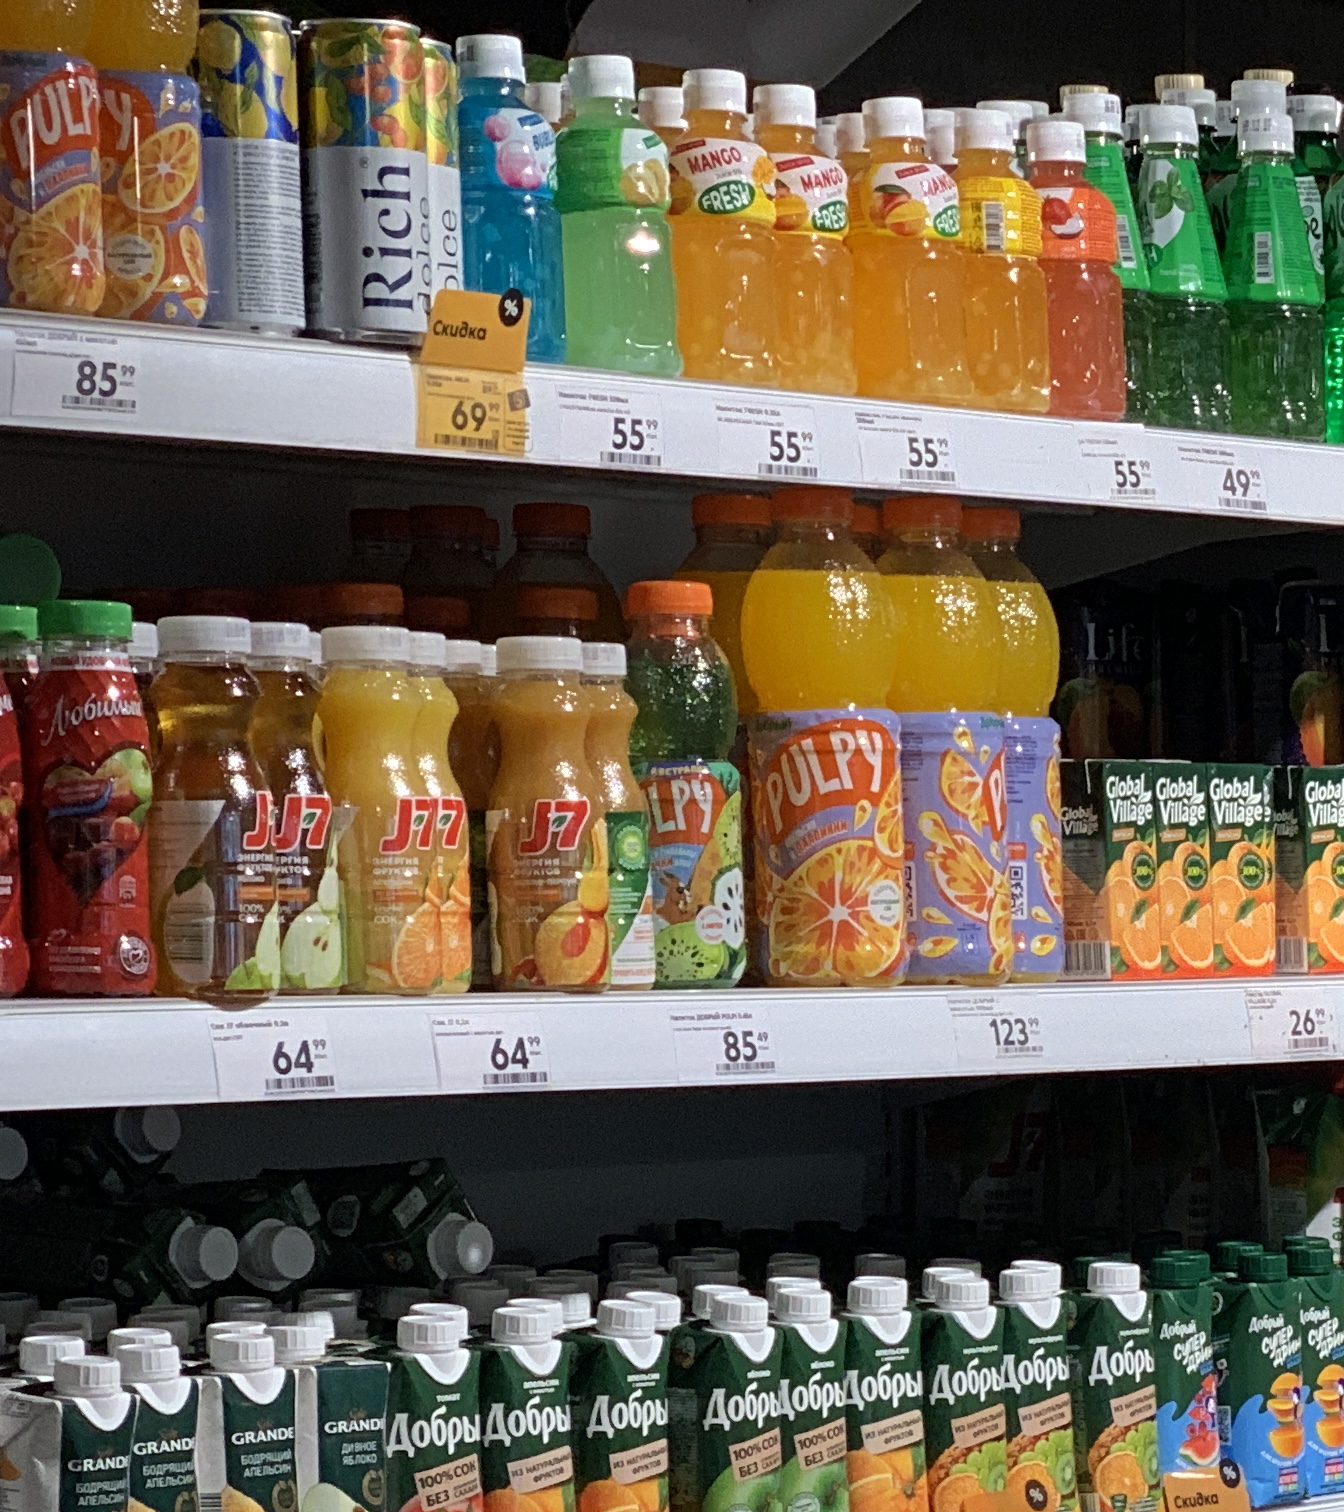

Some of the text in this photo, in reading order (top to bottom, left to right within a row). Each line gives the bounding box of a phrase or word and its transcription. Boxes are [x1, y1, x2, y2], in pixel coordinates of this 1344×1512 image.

[686, 147, 741, 175] MANGO
[799, 167, 844, 194] MANGO
[700, 182, 754, 213] FRESH
[362, 163, 413, 312] Rich
[432, 321, 487, 342] Скидка
[75, 360, 135, 397] 85 99
[451, 401, 487, 432] 69
[611, 418, 658, 450] 55 99
[768, 430, 813, 463] 55 99
[907, 437, 938, 468] 55
[1222, 468, 1251, 497] 49
[766, 729, 884, 833] PULPY
[1106, 774, 1147, 803] Global
[274, 793, 333, 850] J7
[380, 796, 438, 853] J7
[520, 798, 591, 852] J7
[1110, 800, 1153, 827] Village
[989, 1018, 1040, 1046] 123 99
[1288, 1009, 1316, 1036] 26
[272, 1038, 326, 1074] 64 99
[490, 1036, 541, 1070] 64 99
[723, 1031, 769, 1062] 85 49
[1248, 1314, 1284, 1334] Добрый
[1261, 1324, 1294, 1357] СУПЕР
[436, 1392, 461, 1403] томат
[231, 1427, 295, 1446] GRANDE
[386, 1405, 481, 1458] Добры
[240, 1449, 292, 1466] БОДРЯЩИЙ
[341, 1440, 377, 1455] ДИВНОЕ
[342, 1453, 377, 1466] ЯБЛОКО
[243, 1463, 292, 1478] АПЕЛЬСИН
[418, 1462, 478, 1489] 100% СОК
[426, 1488, 450, 1507] БЕЗ
[1173, 1492, 1219, 1510] Скидка
